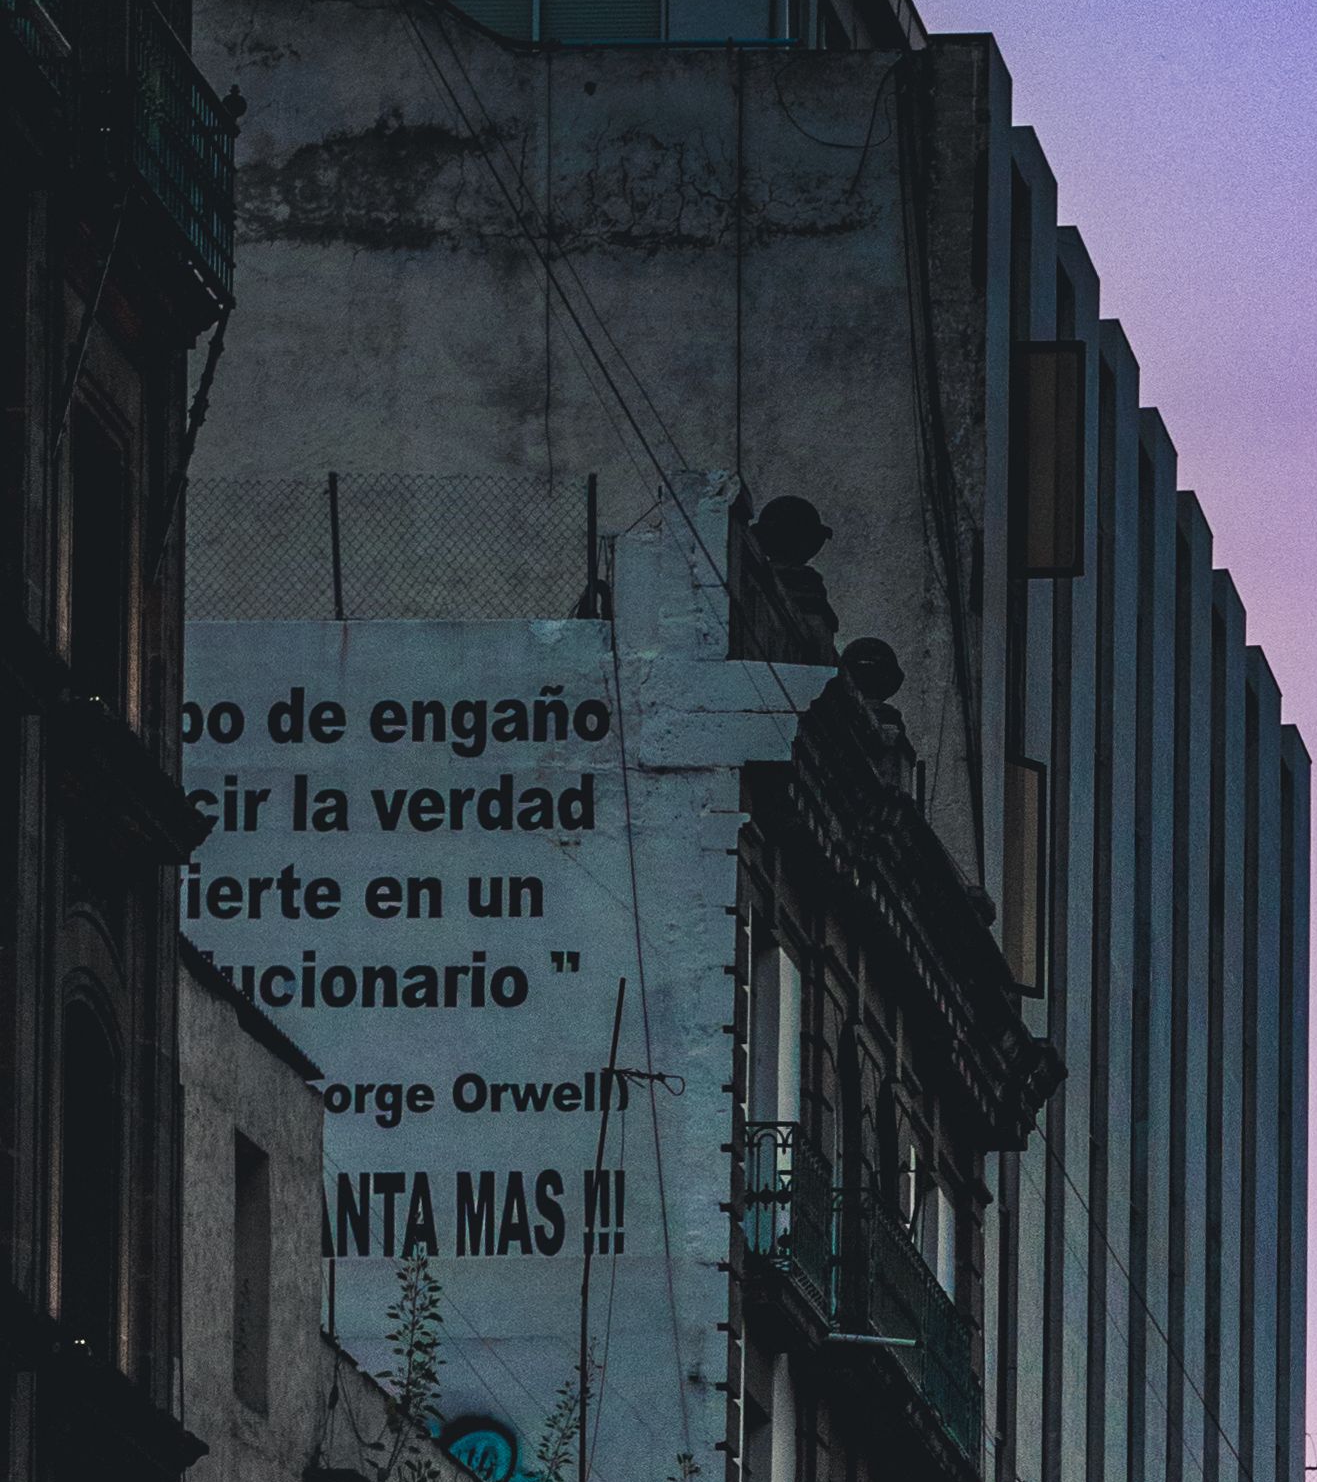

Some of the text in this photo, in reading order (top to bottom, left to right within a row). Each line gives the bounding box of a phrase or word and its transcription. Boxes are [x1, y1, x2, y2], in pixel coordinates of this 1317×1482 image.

[267, 687, 347, 744] de
[370, 684, 612, 758] engaño
[293, 774, 349, 832] la
[371, 773, 596, 832] verdad
[182, 863, 544, 919] ierte en un
[200, 950, 529, 1008] ucionario
[312, 1083, 435, 1129] orge
[455, 1169, 565, 1257] MAS
